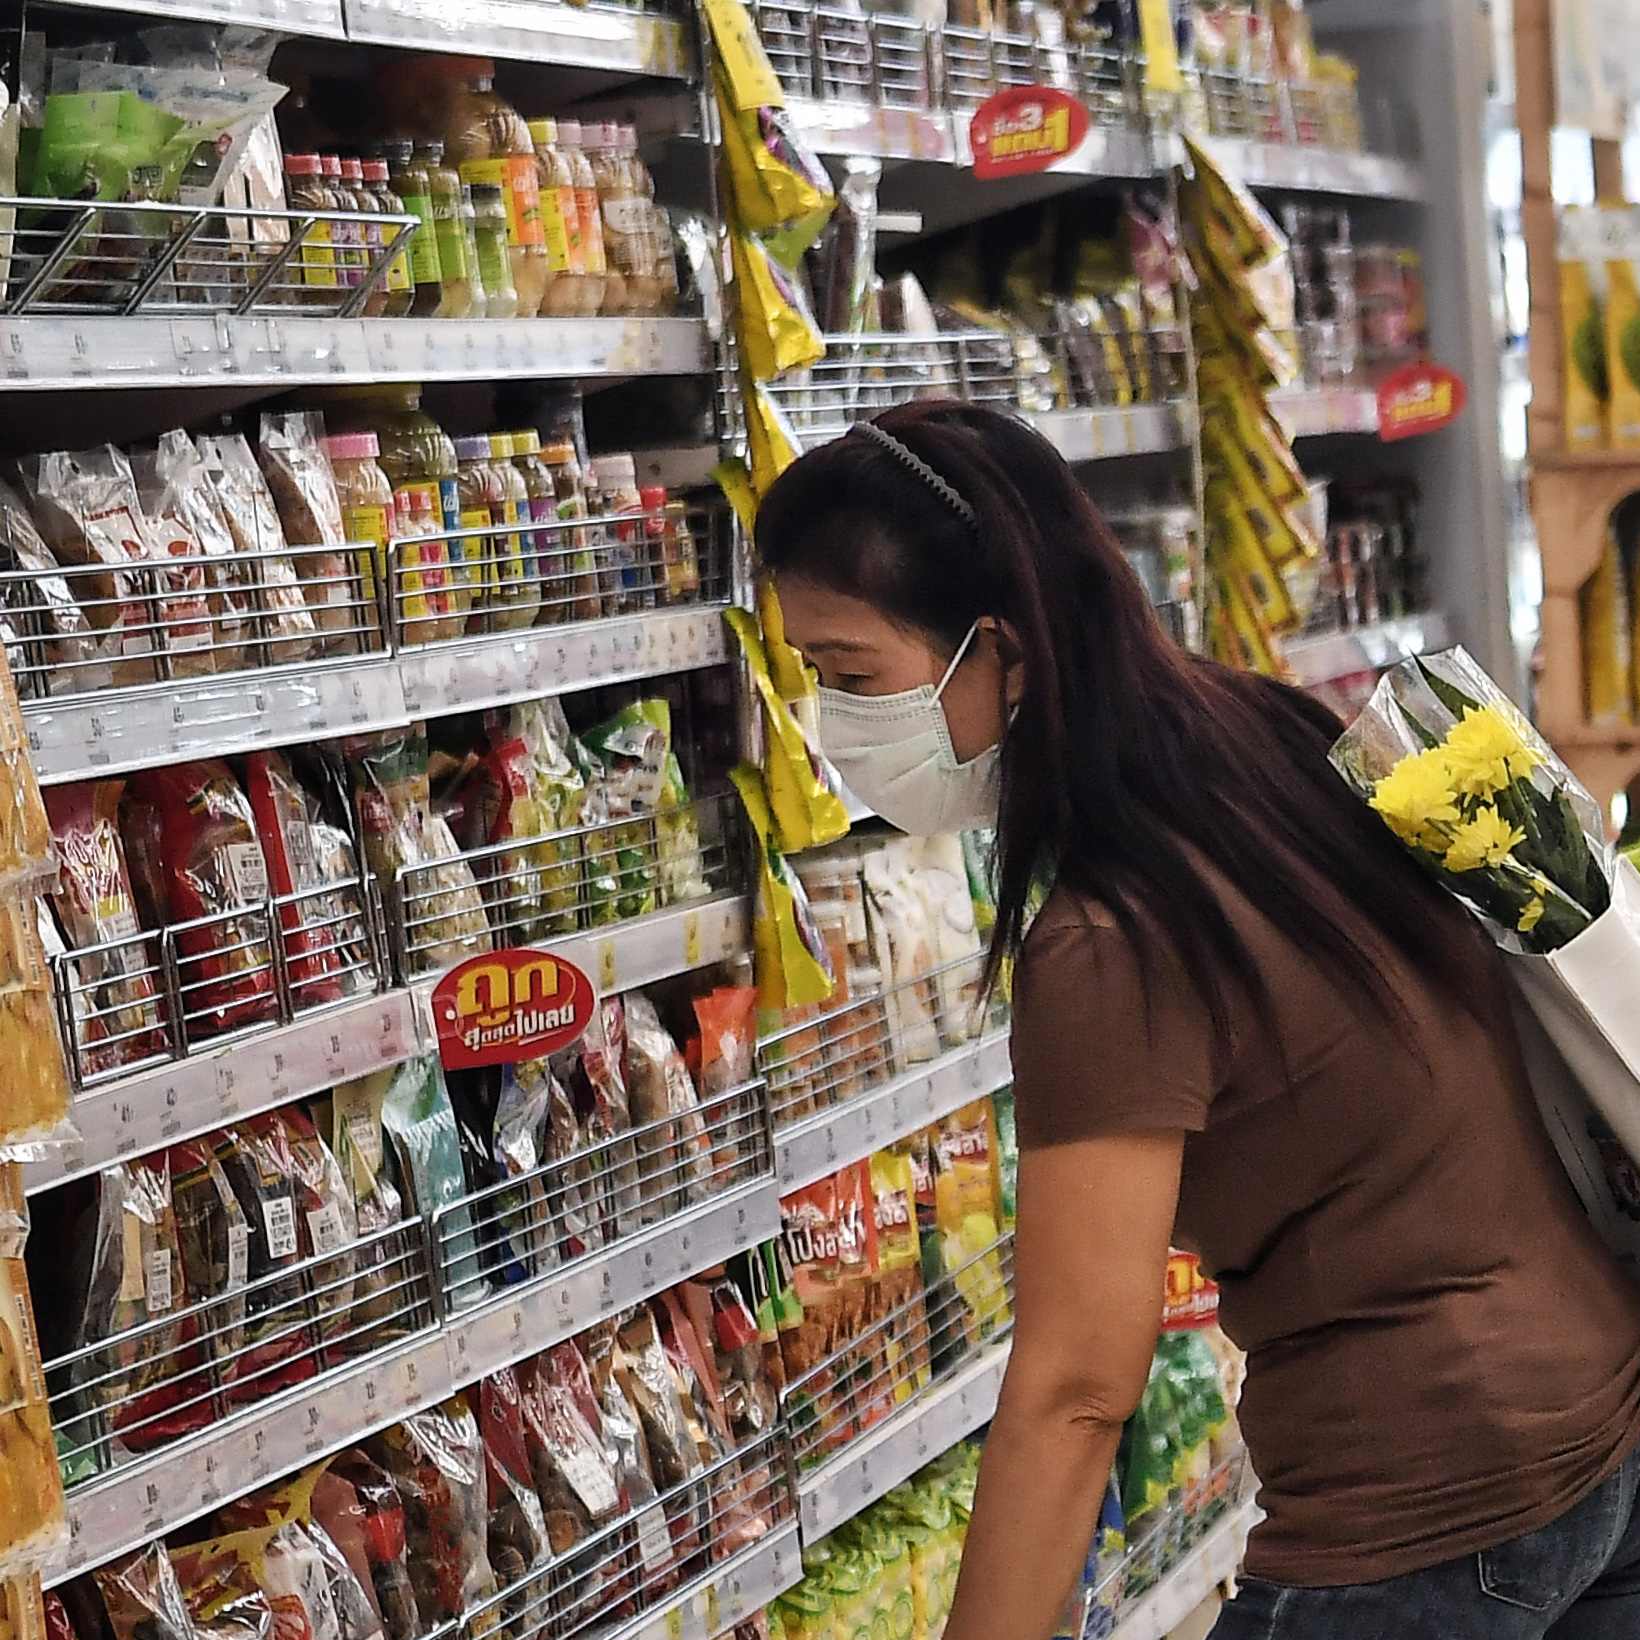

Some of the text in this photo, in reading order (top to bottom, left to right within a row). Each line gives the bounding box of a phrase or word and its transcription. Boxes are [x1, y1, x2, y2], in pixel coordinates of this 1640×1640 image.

[456, 959, 559, 1028] ถูก
[464, 1003, 575, 1052] สุดสุดไปเลย
